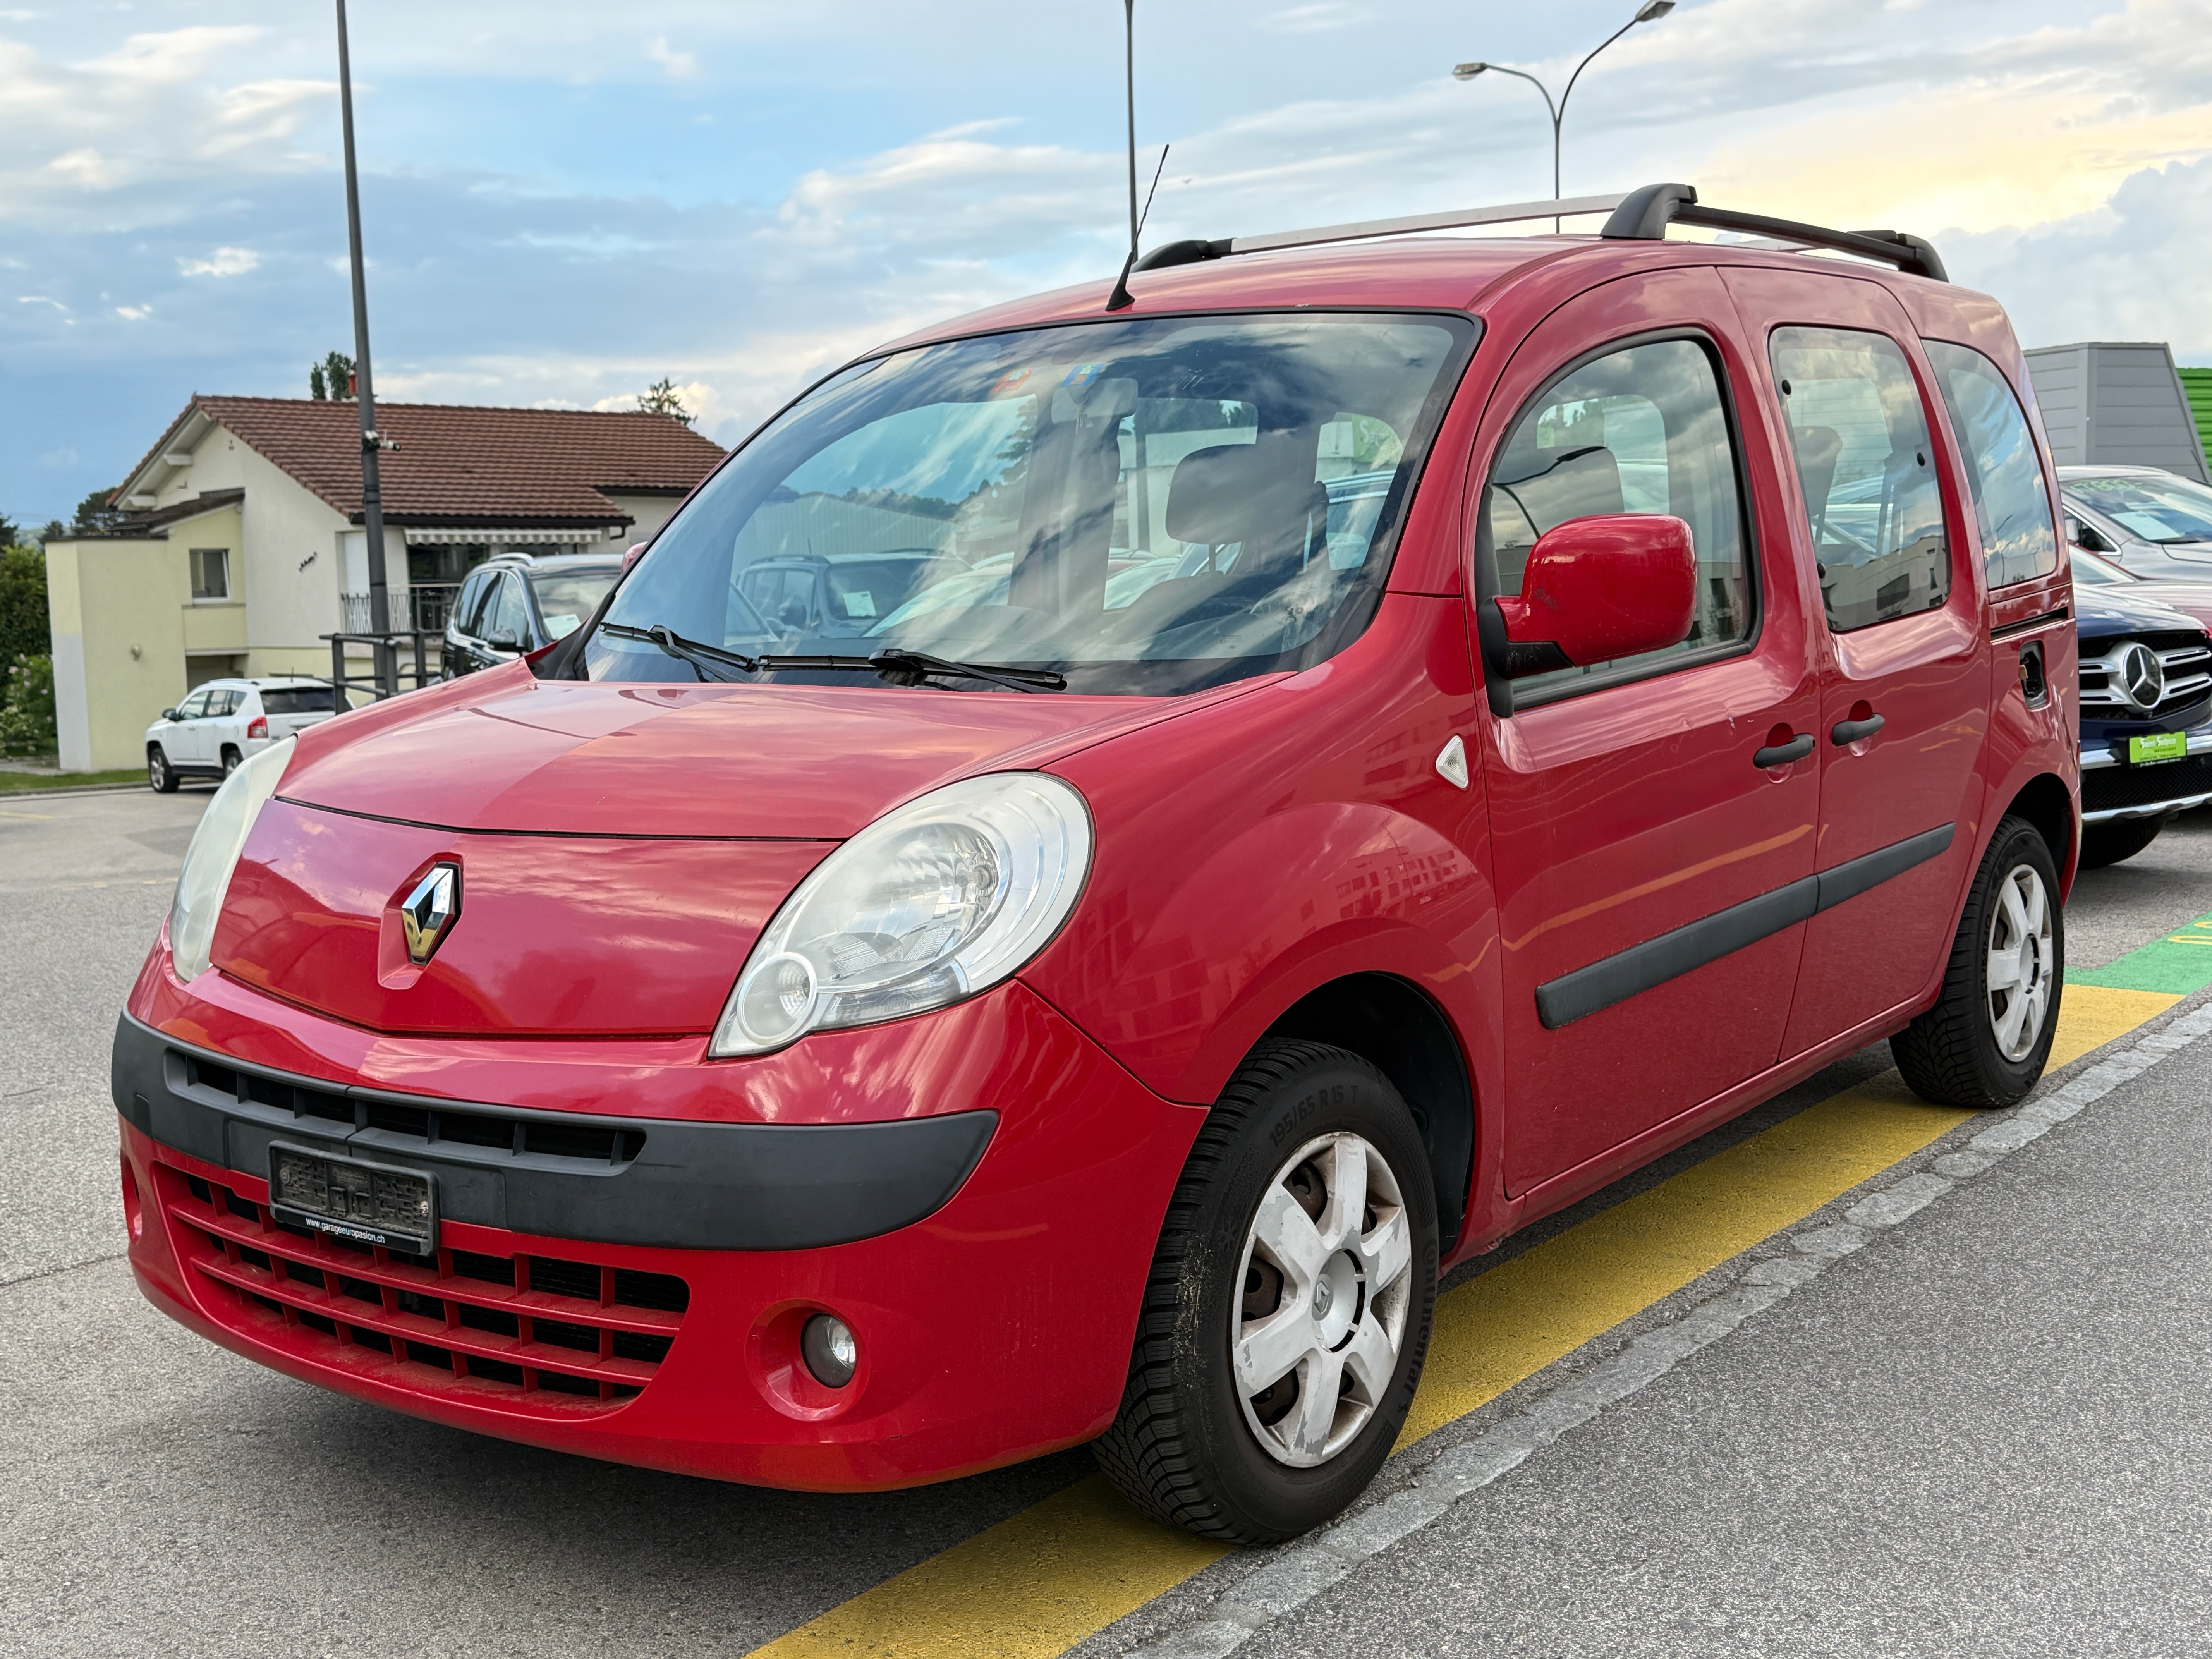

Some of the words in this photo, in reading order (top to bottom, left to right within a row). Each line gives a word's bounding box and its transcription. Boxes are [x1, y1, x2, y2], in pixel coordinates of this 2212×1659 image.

[1269, 1095, 1316, 1148] 195/65
[1351, 1085, 1358, 1104] T
[1403, 1238, 1437, 1395] Continental
